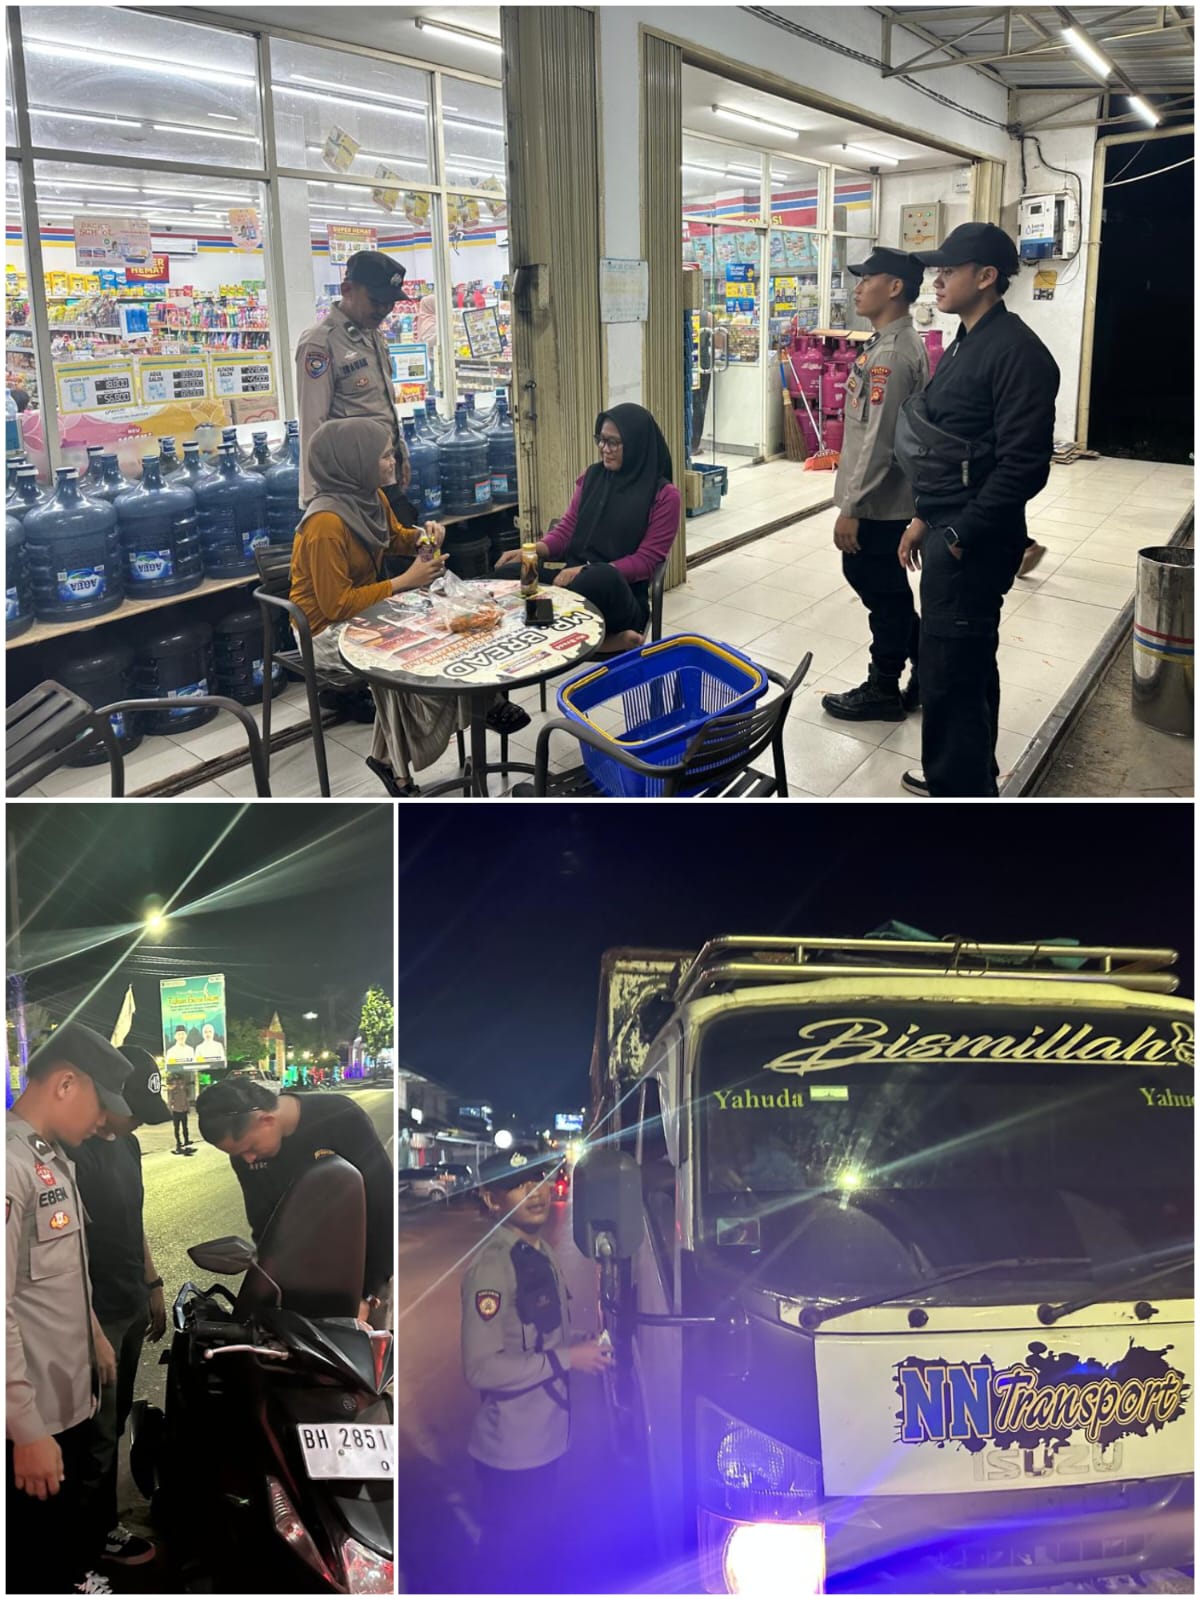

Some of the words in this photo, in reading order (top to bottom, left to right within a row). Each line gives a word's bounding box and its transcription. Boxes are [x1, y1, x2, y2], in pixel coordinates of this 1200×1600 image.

[131, 266, 164, 274] HEMAT
[70, 578, 97, 591] AQUA
[443, 631, 547, 677] BREAD
[762, 1017, 1178, 1077] Bismillah
[713, 1088, 804, 1110] Yahuda
[900, 1364, 992, 1442] NN
[994, 1363, 1184, 1443] Transport
[303, 1429, 329, 1449] BH
[339, 1428, 389, 1450] 2851
[972, 1442, 1123, 1482] ISUZU
